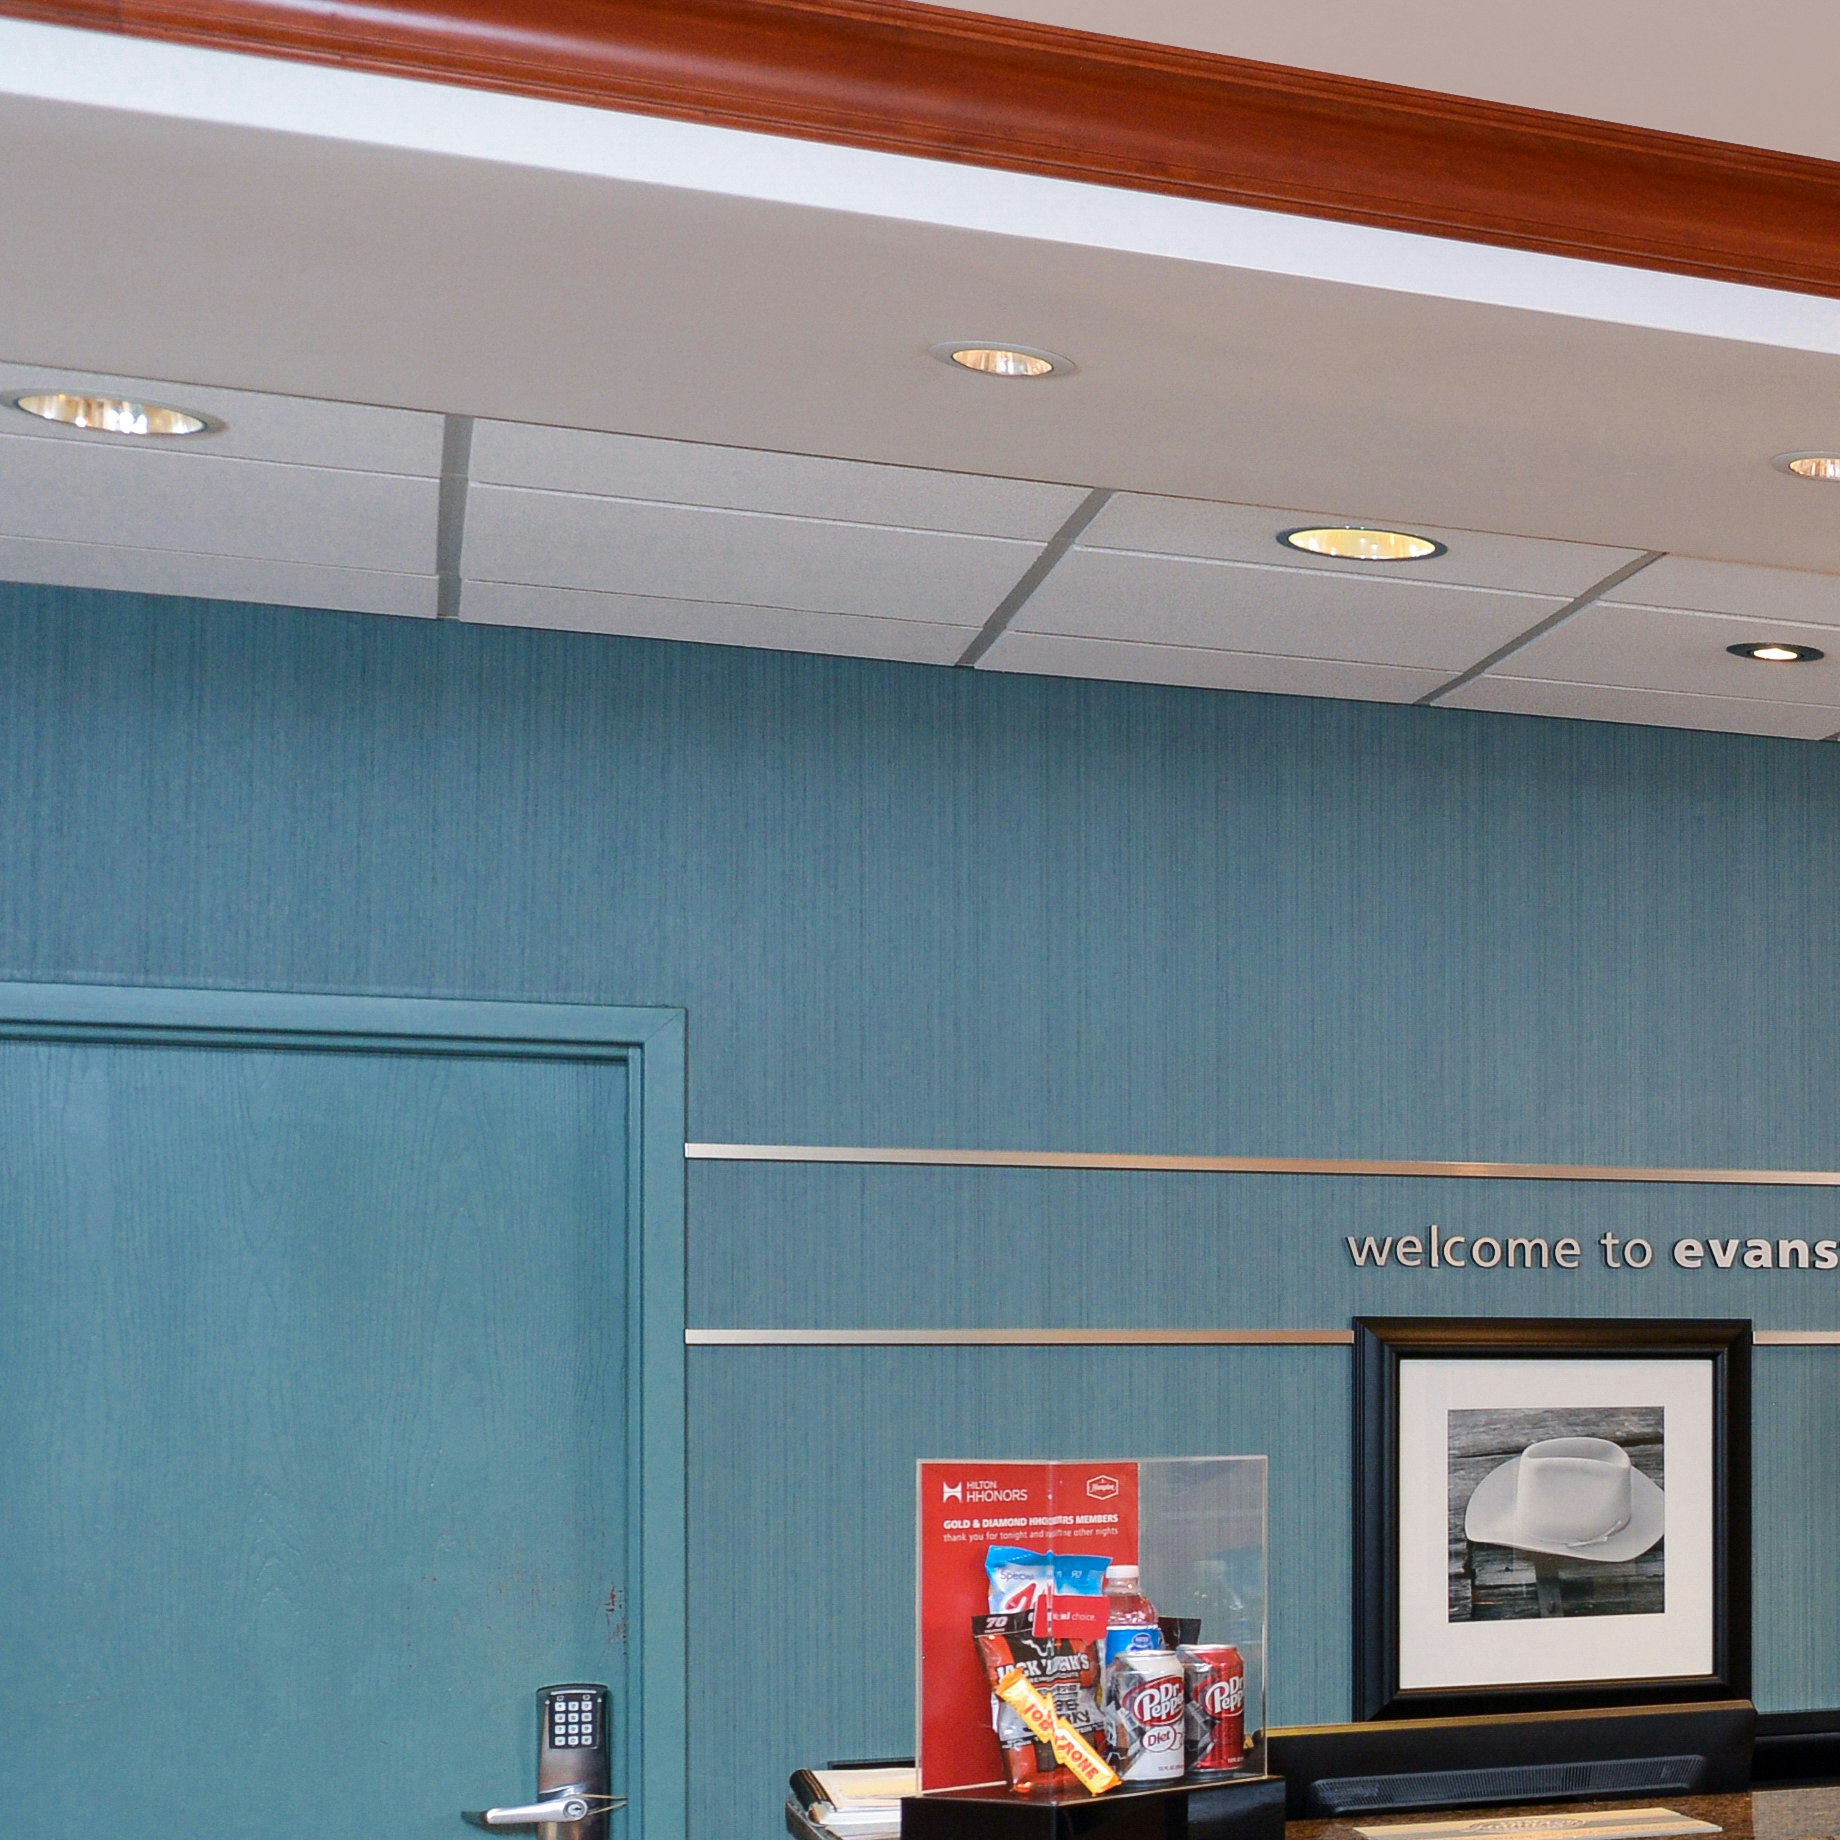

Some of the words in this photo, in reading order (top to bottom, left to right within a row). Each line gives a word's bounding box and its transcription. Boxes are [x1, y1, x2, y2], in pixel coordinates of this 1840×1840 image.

[1346, 1223, 1582, 1270] welcome
[1599, 1231, 1653, 1270] to
[967, 1480, 997, 1489] HILTON
[967, 1489, 1028, 1502] HHONORS
[943, 1519, 970, 1529] GOLD
[972, 1519, 980, 1528] &
[982, 1517, 1027, 1528] DIAMOND
[1029, 1515, 1074, 1526] HHORS
[1076, 1513, 1119, 1524] MEMBERS
[943, 1532, 967, 1542] thank
[969, 1533, 984, 1543] you
[986, 1531, 998, 1541] for
[1000, 1530, 1028, 1542] tonight
[1030, 1529, 1044, 1539] and
[1074, 1527, 1093, 1537] other
[1095, 1527, 1119, 1537] nights
[985, 1616, 1008, 1628] 70
[1160, 1683, 1179, 1702] Dr
[1205, 1681, 1244, 1714] Pepp
[1134, 1688, 1184, 1722] Peppe
[1148, 1731, 1170, 1747] Diet
